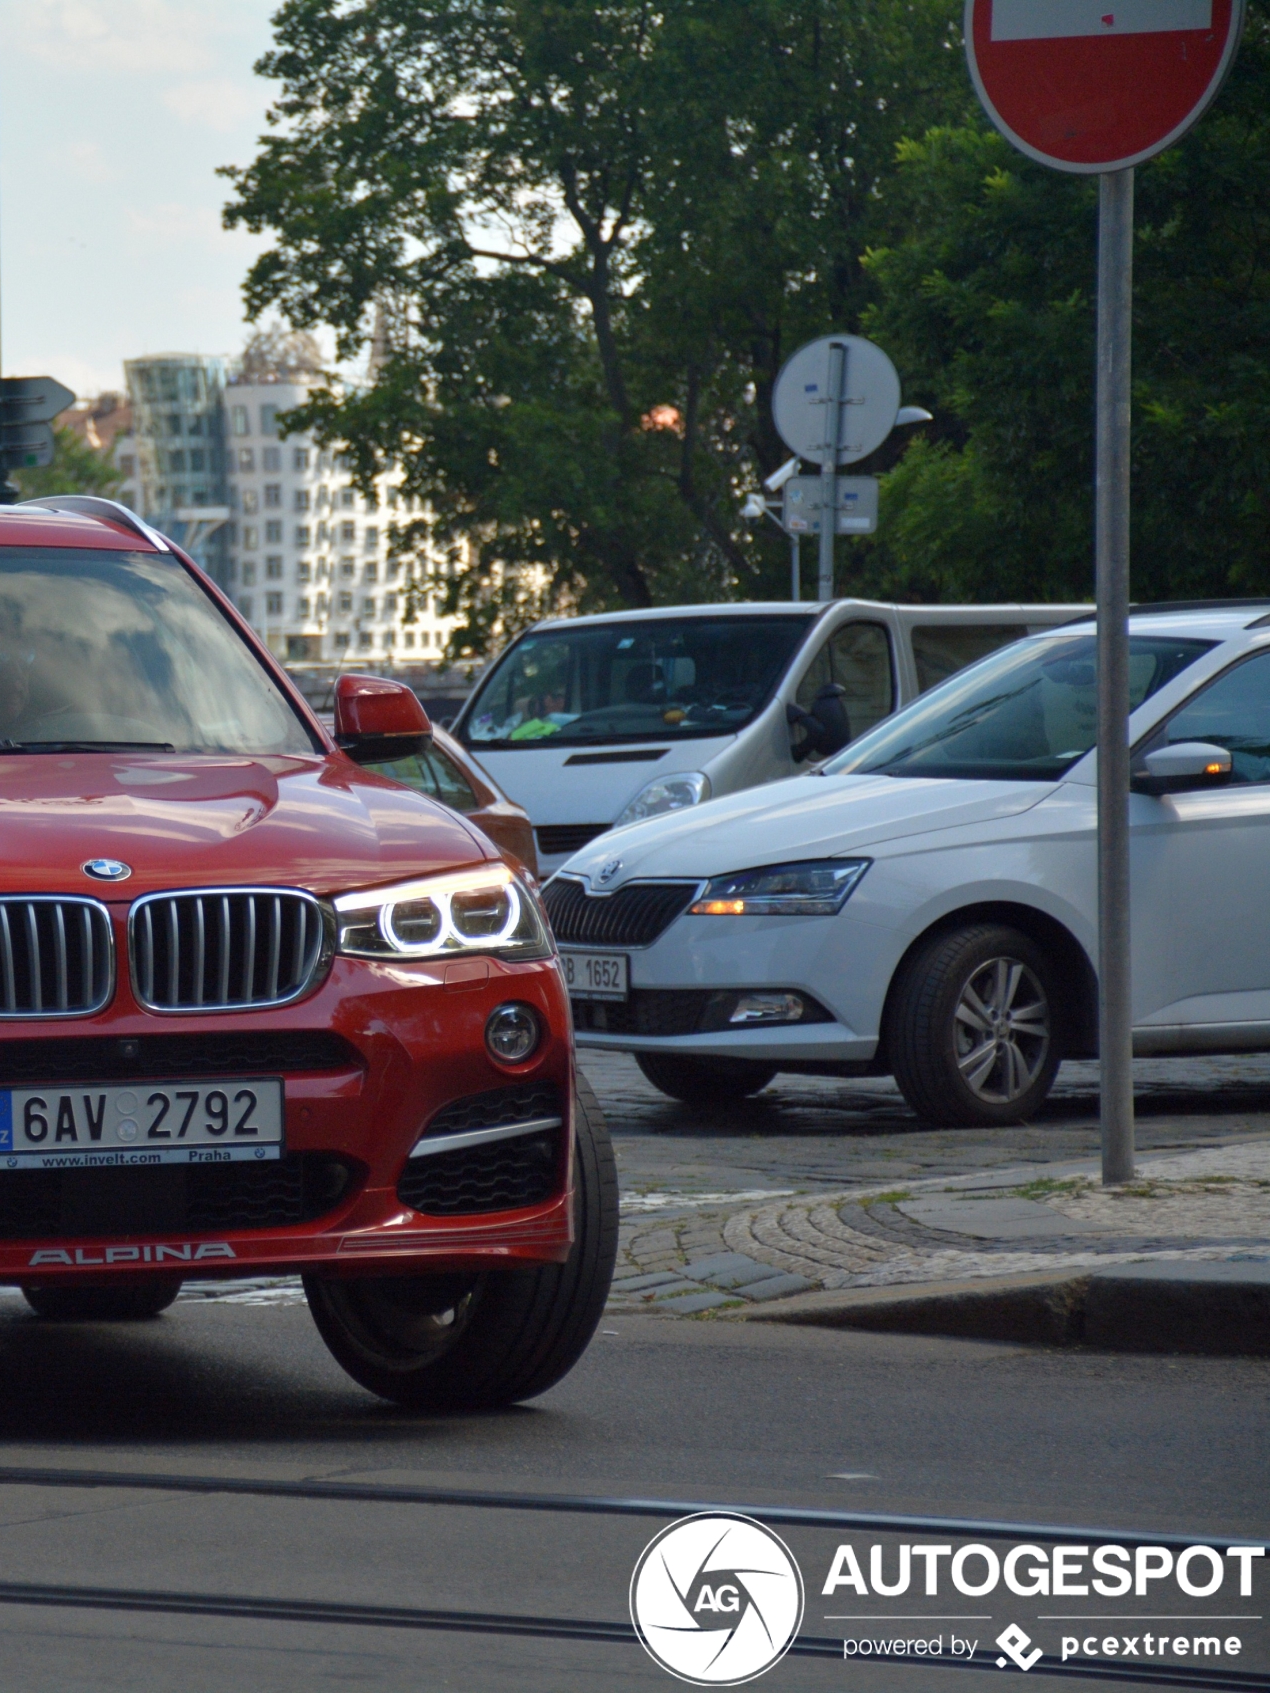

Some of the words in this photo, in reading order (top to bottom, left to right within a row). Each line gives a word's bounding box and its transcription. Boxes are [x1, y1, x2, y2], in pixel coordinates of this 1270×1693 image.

[586, 958, 620, 988] 1652
[23, 1094, 107, 1143] 6AV
[146, 1089, 259, 1139] 2792
[41, 1151, 161, 1168] www.invelt.com
[188, 1149, 232, 1162] Praha
[28, 1242, 237, 1266] ALPINA
